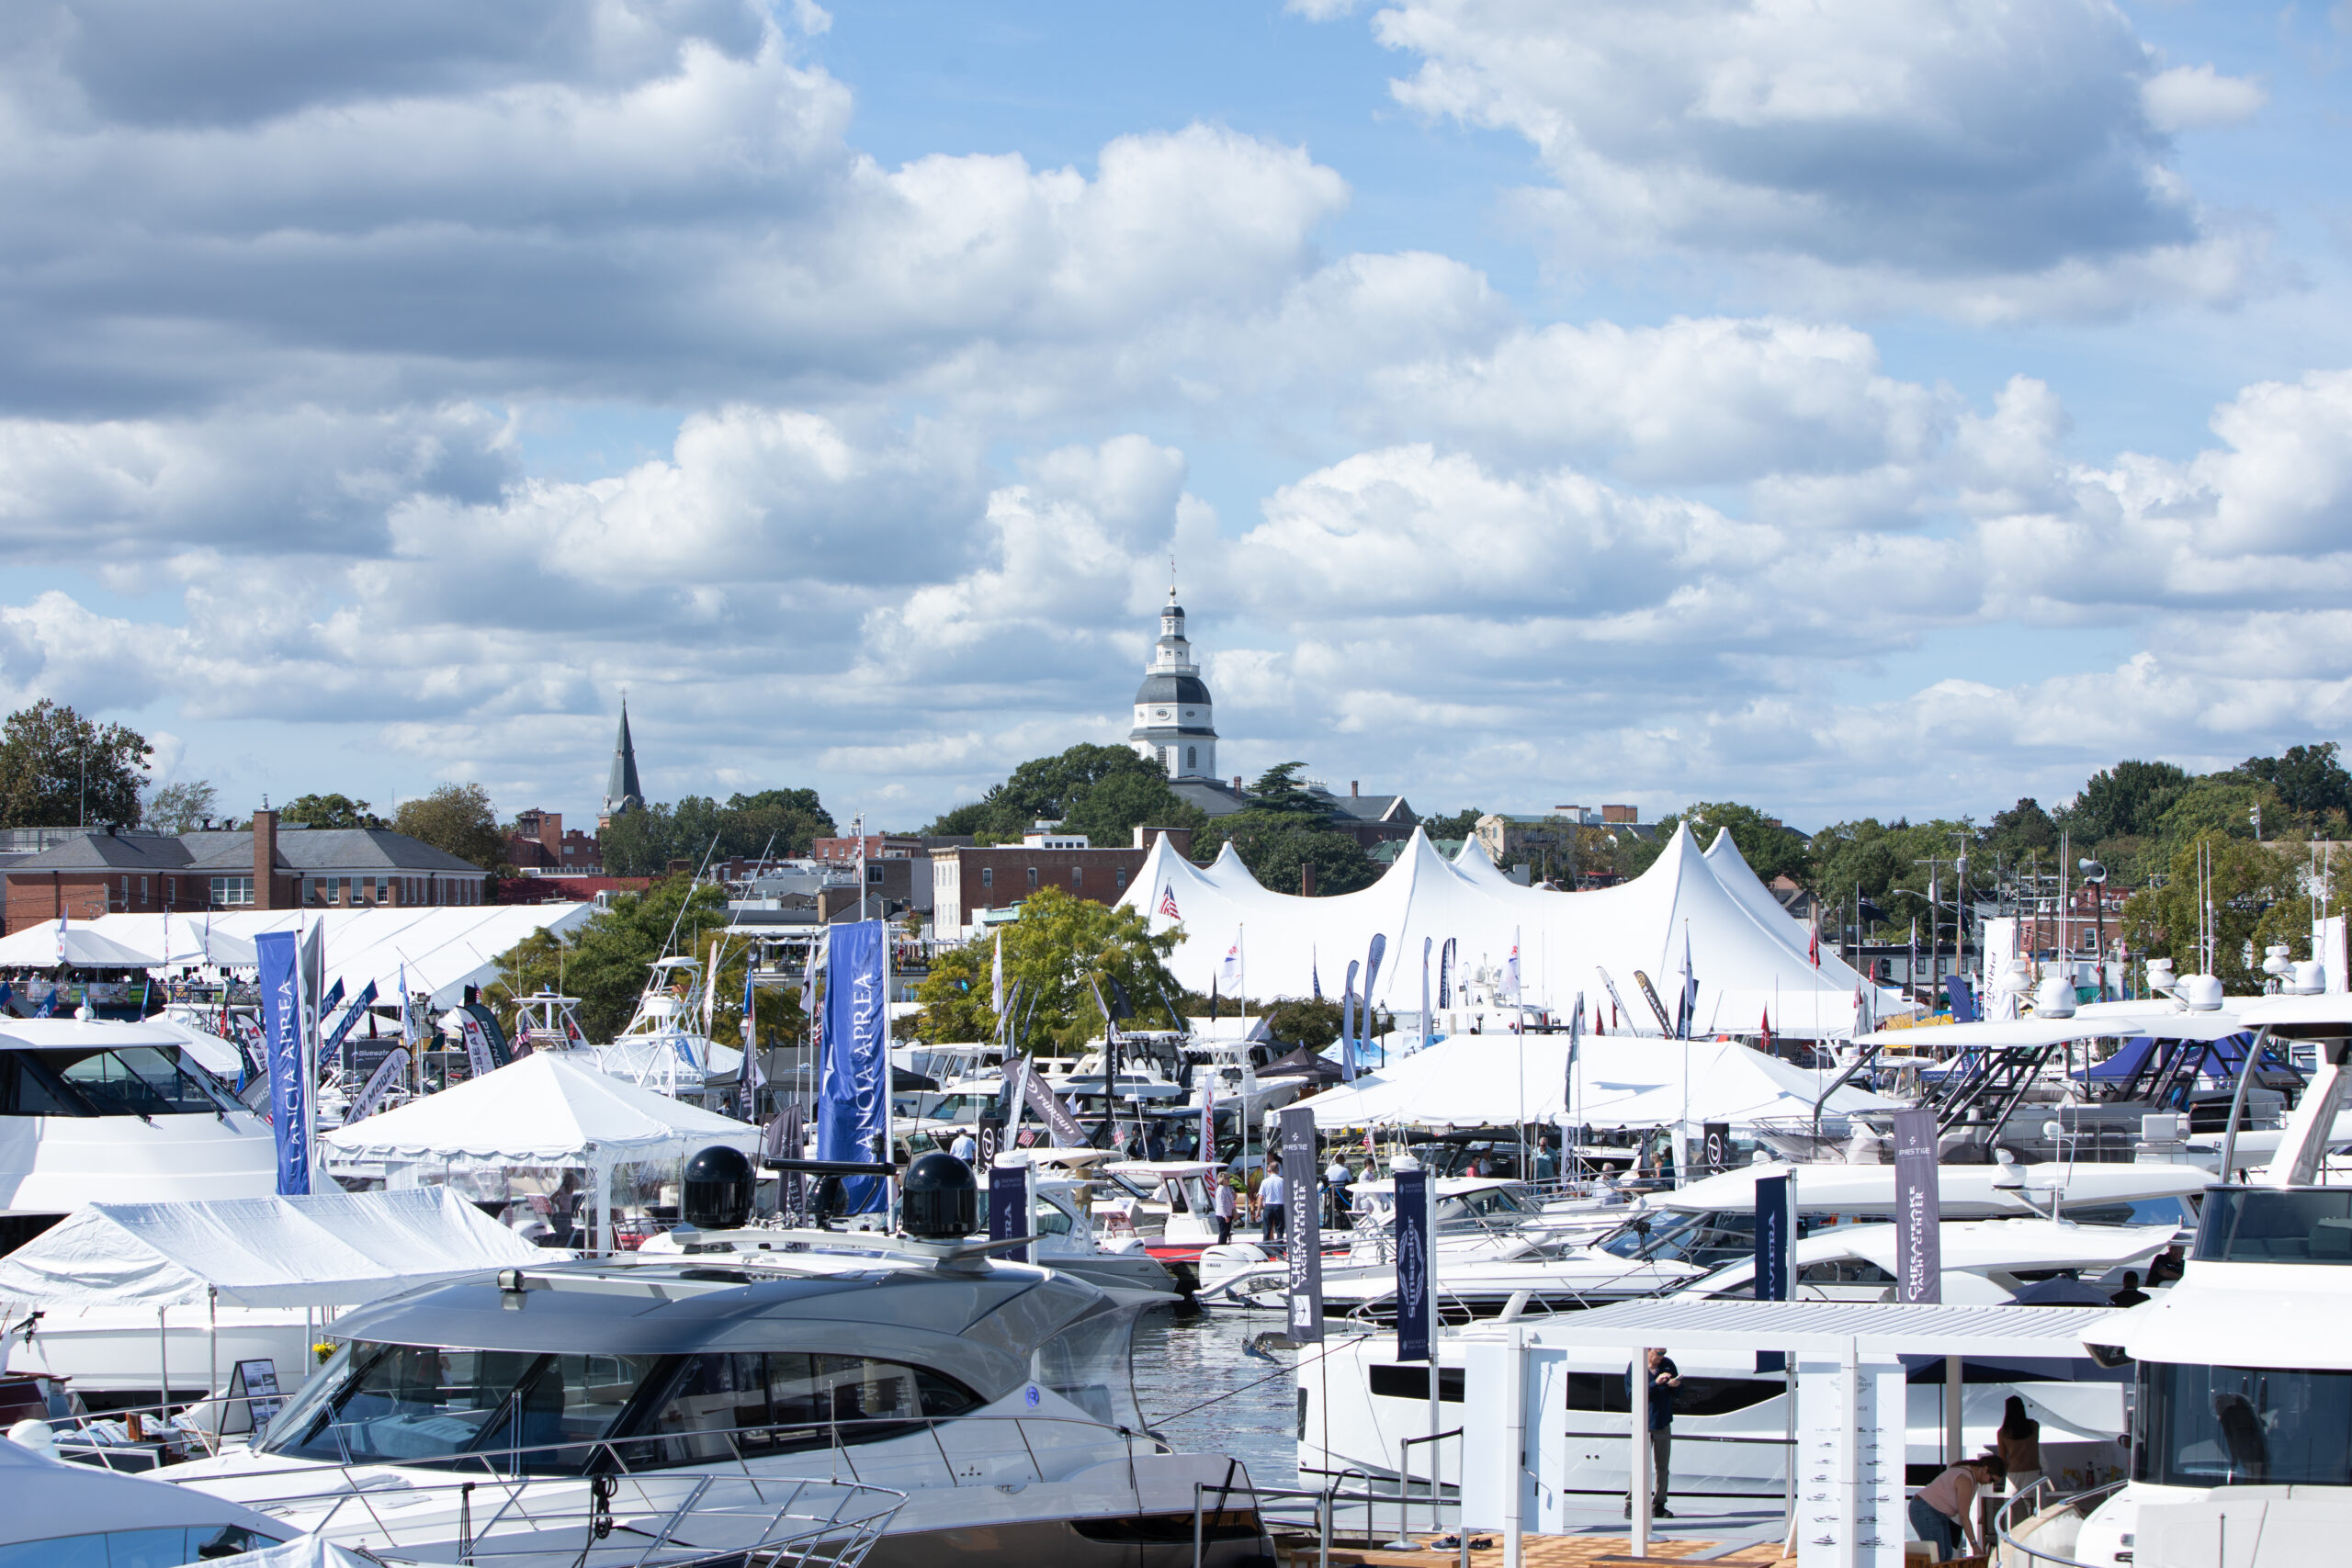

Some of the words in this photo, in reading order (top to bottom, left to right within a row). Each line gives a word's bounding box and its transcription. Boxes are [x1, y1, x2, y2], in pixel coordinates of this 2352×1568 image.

[277, 979, 295, 1059] APREA
[321, 993, 368, 1064] EGULATOR
[853, 971, 873, 1060] APREA
[283, 1068, 301, 1163] LANCIA
[368, 1062, 399, 1100] MODEL
[855, 1064, 875, 1163] ANCIA
[1036, 1093, 1076, 1135] PURSUIT
[1290, 1179, 1300, 1290] CHESAPEAKE
[1299, 1185, 1307, 1236] CENTER
[1907, 1184, 1918, 1302] CHESAPEAKE
[1915, 1190, 1925, 1246] CENTER
[1300, 1240, 1308, 1283] YACHT
[1916, 1248, 1925, 1294] YACHT
